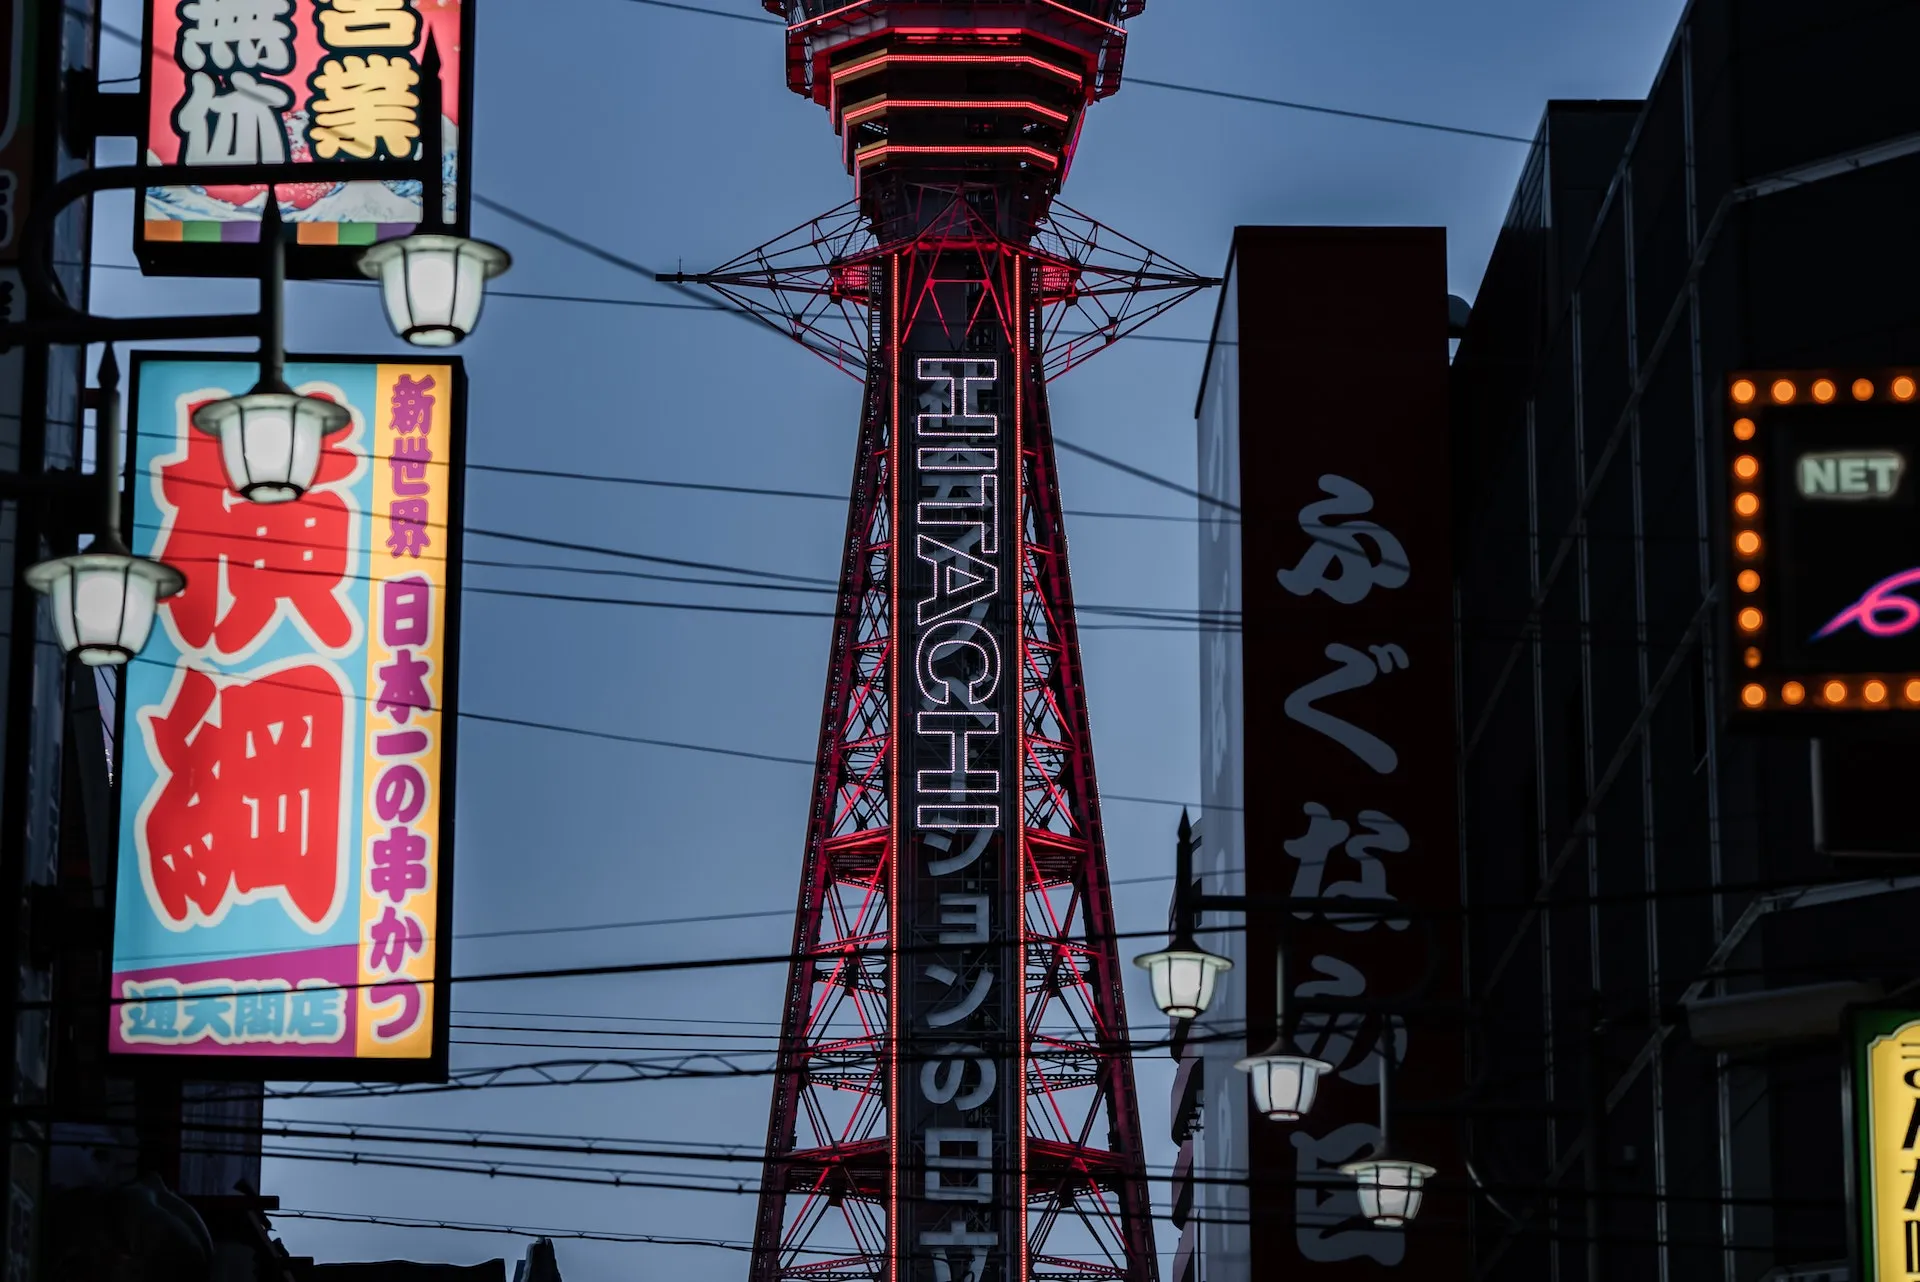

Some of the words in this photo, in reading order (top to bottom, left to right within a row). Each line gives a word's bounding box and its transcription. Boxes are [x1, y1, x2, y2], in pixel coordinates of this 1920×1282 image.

[387, 373, 436, 558] 新世界
[1800, 455, 1902, 496] NET
[916, 358, 1001, 828] HITACHI
[368, 575, 433, 1042] 日本一の串かつ
[124, 981, 345, 1042] 通天閣店
